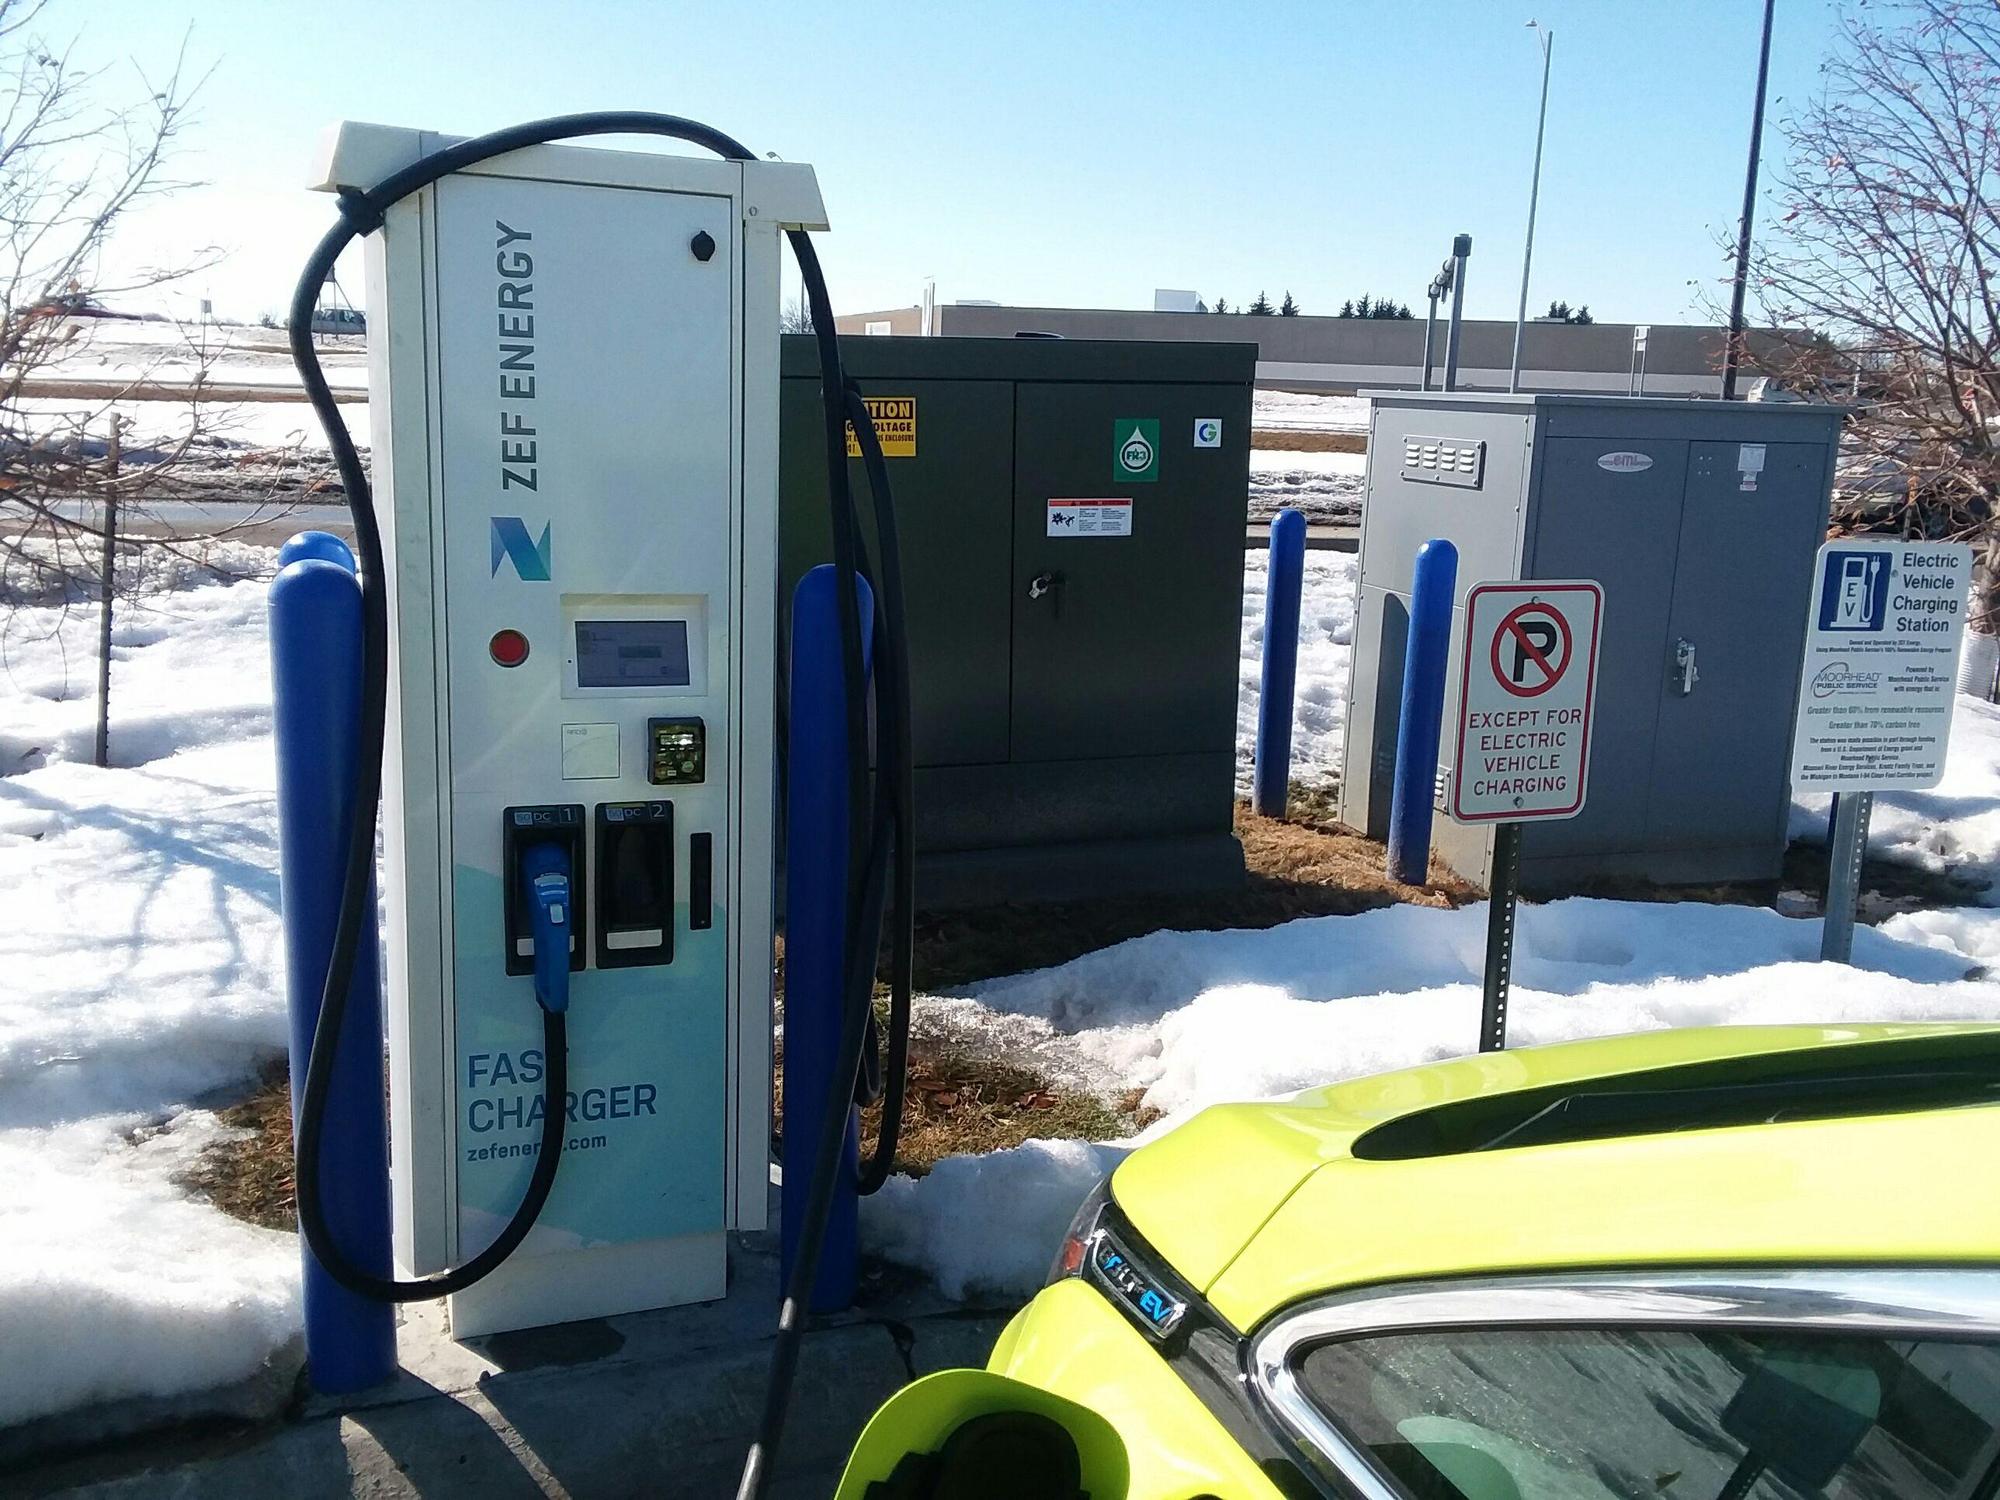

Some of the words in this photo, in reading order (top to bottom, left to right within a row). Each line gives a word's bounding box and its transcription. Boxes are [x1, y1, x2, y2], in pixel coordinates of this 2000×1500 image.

[496, 219, 536, 399] ENERGY
[864, 401, 911, 418] TION
[873, 422, 912, 432] OLTAGE
[501, 411, 538, 492] ZEF
[1903, 553, 1959, 567] Electric
[1903, 574, 1955, 589] Vehicle
[1893, 595, 1959, 614] Charging
[1896, 617, 1949, 632] Station
[1816, 673, 1880, 682] MOORHEAD
[1469, 710, 1540, 729] EXCEPT
[1547, 708, 1582, 725] FOR
[1480, 731, 1567, 751] ELECTRIC
[1484, 753, 1561, 774] VEHICLE
[1473, 775, 1567, 796] CHARGING
[563, 808, 572, 820] 1
[652, 804, 665, 818] 2
[468, 1050, 569, 1088] FAS
[467, 1135, 607, 1162] zefener.com
[1140, 1289, 1173, 1322] EV
